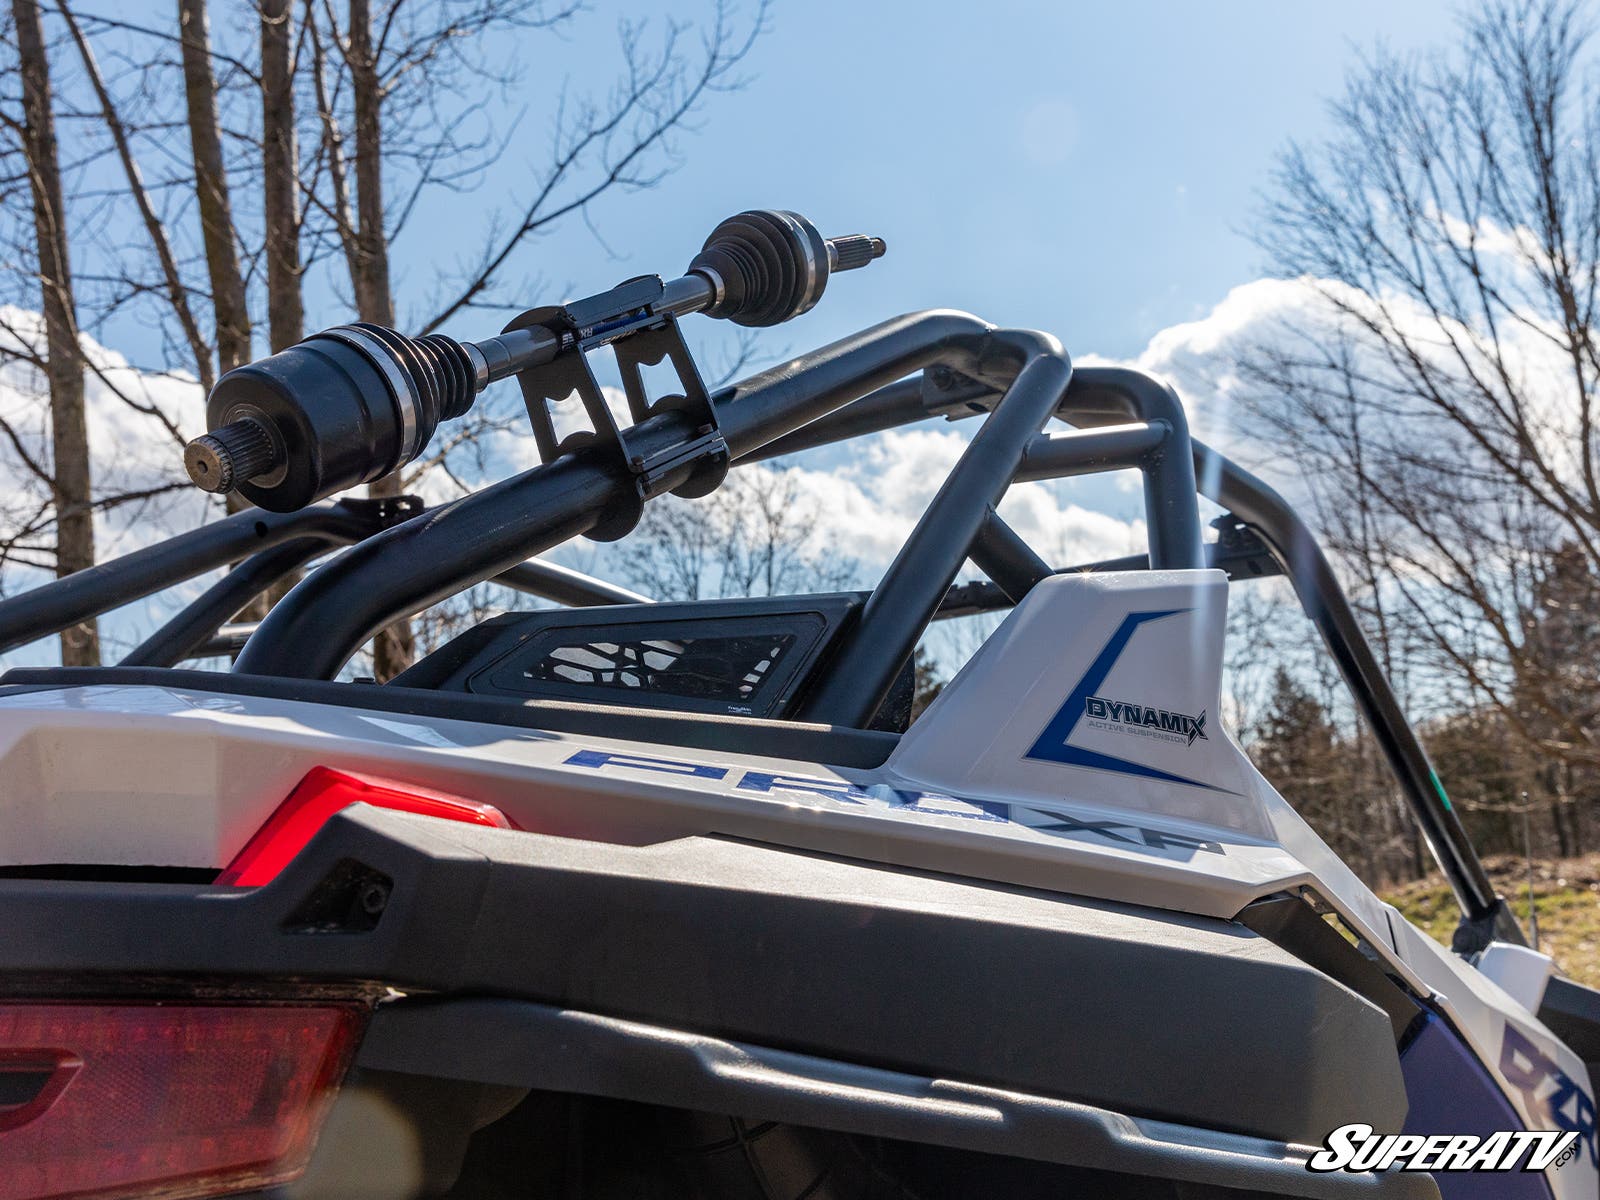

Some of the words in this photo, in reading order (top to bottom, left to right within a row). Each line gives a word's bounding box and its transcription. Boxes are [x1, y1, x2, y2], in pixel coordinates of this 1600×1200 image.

[1085, 696, 1208, 747] DYNAMIX
[1088, 720, 1125, 733] ACTIVE
[1127, 726, 1187, 744] SUSPENSION
[1023, 806, 1227, 856] XP
